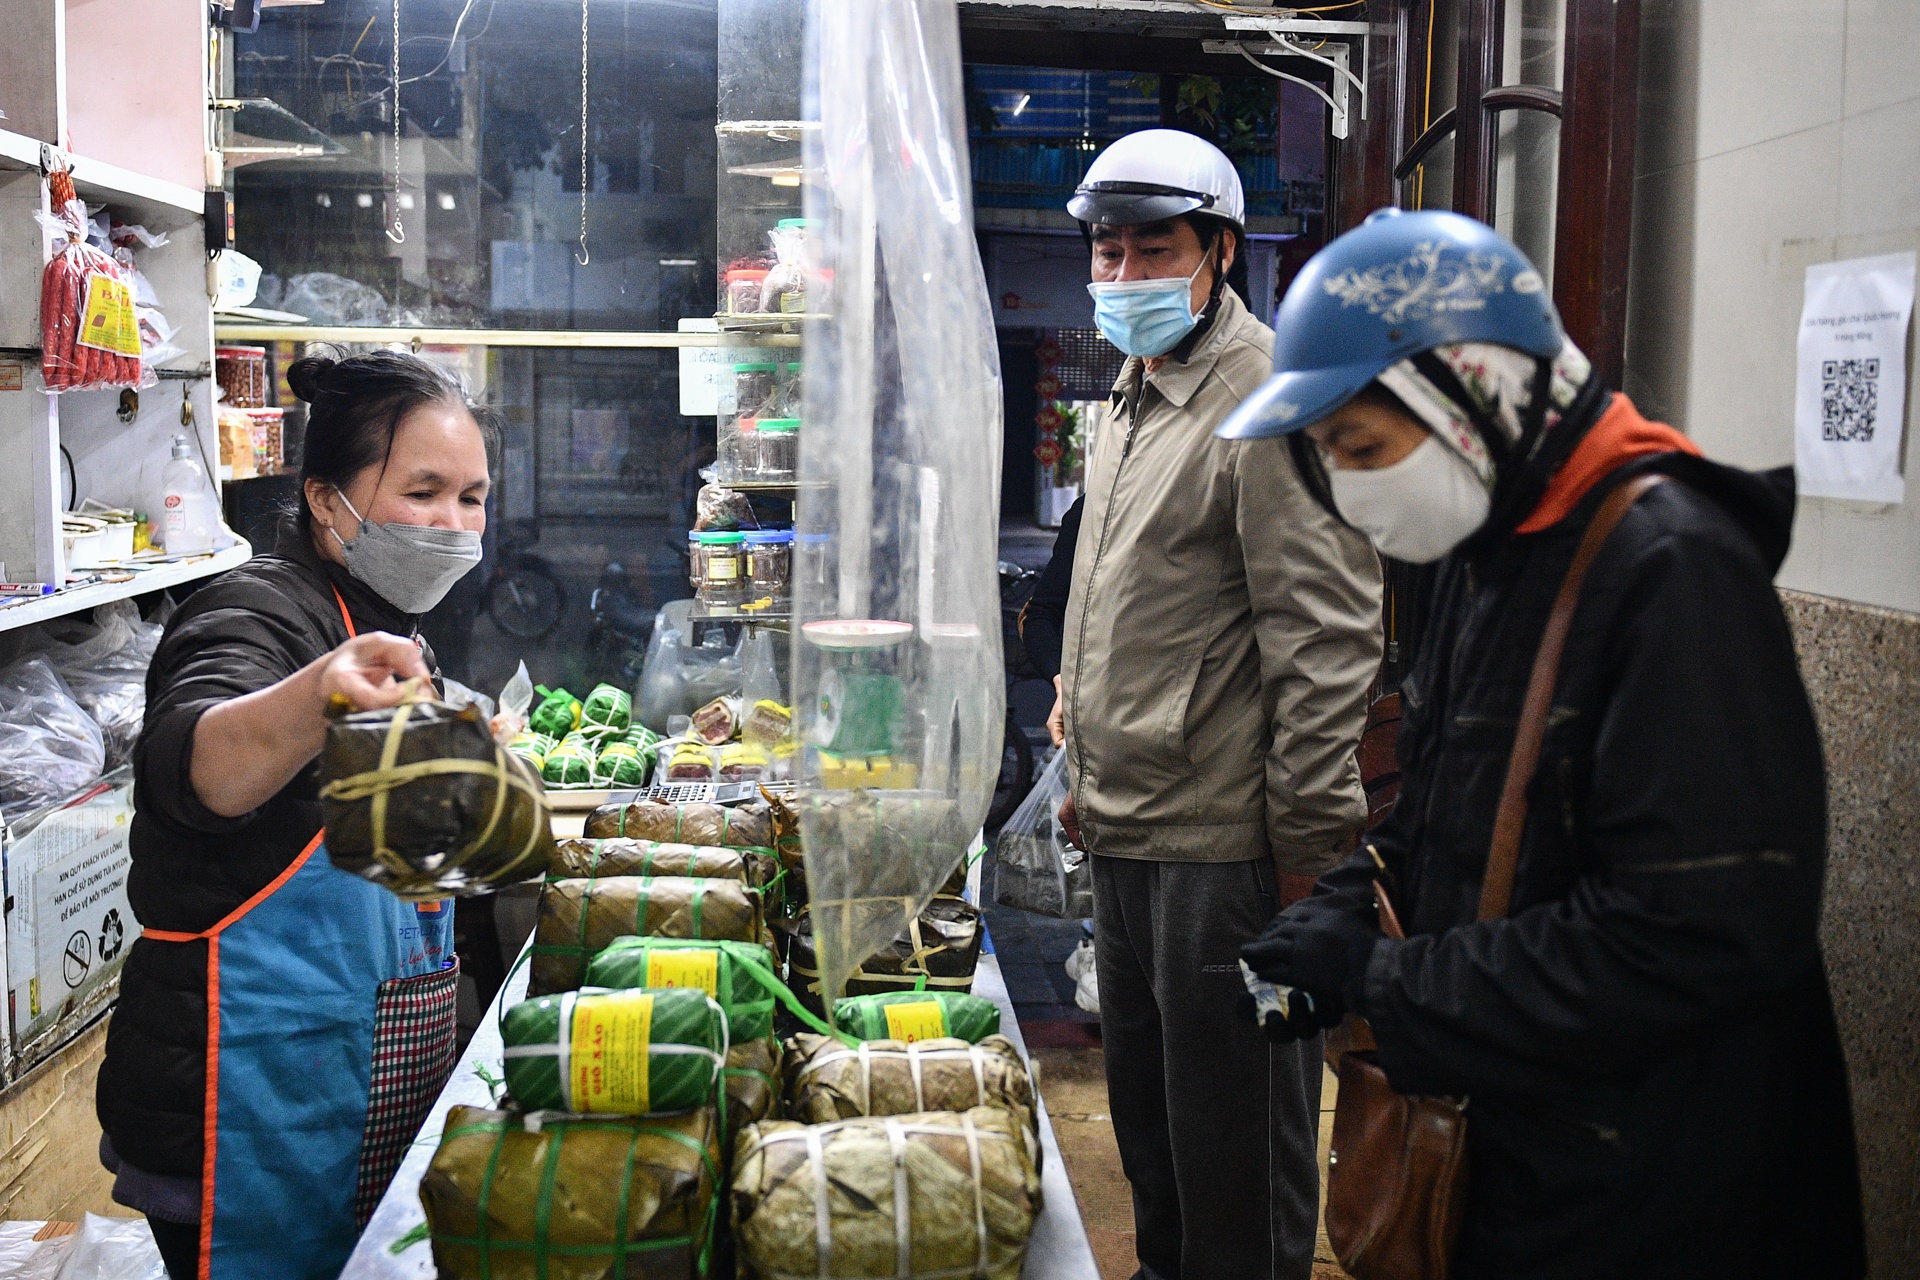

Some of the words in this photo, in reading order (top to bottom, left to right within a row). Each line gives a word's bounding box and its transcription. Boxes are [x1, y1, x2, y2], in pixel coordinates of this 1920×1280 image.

[54, 891, 67, 906] HẠN
[67, 881, 79, 898] CHẾ
[79, 877, 87, 892] SỬ
[87, 871, 102, 886] DỤNG
[103, 864, 112, 877] TÚI
[112, 856, 128, 872] NYLON
[59, 870, 69, 883] XIN
[69, 862, 81, 877] QUÝ
[83, 854, 100, 870] KHÁCH
[100, 849, 110, 860] VUI
[109, 840, 123, 855] LÒNG
[69, 902, 81, 917] BẢO
[89, 890, 100, 904] MÔI
